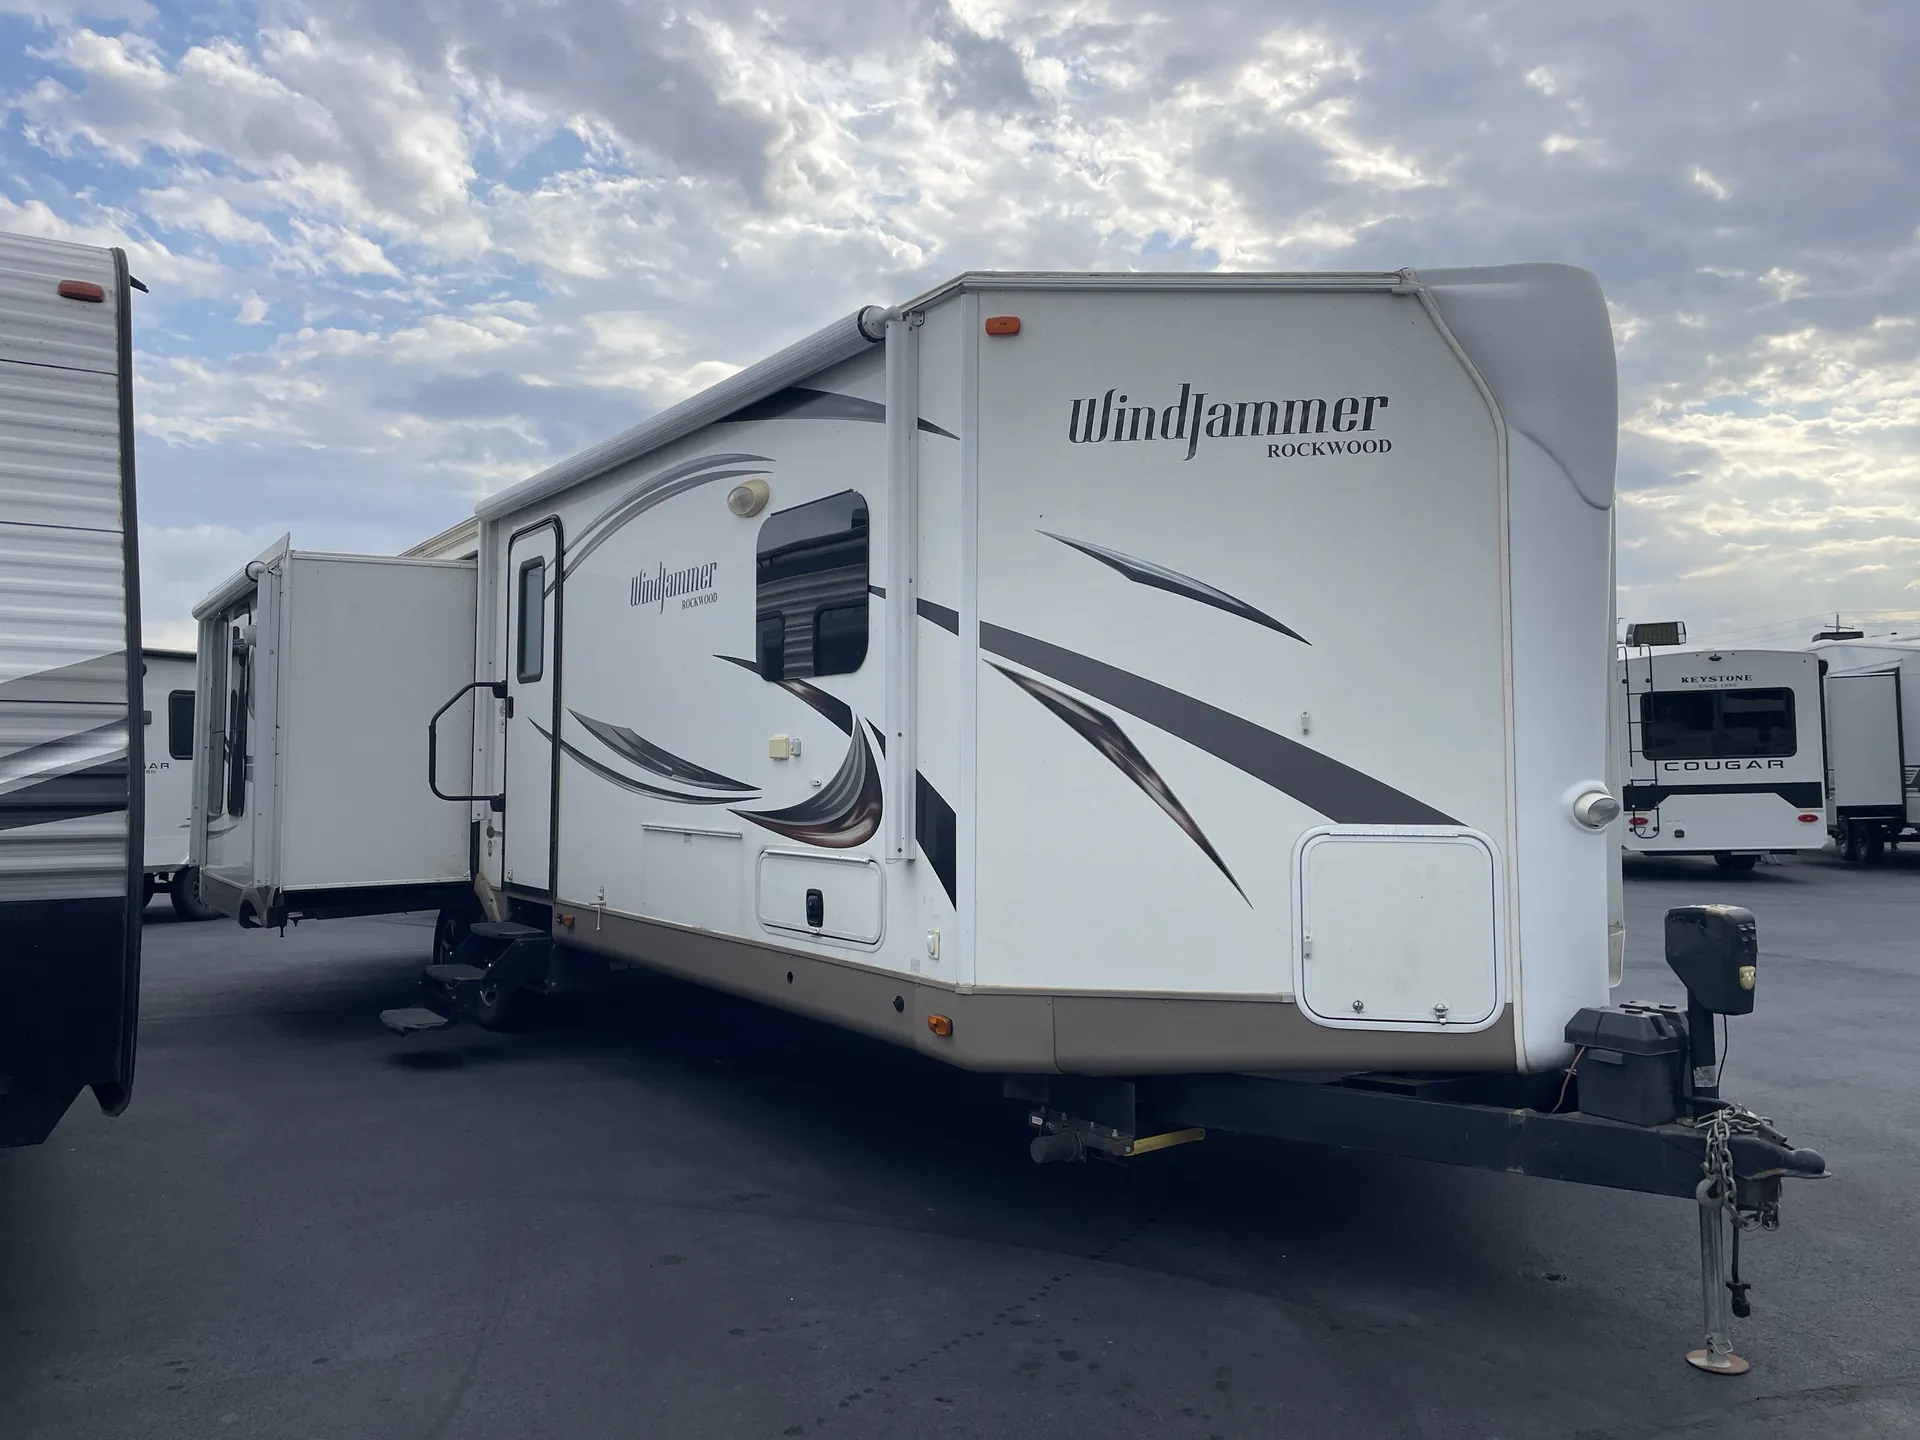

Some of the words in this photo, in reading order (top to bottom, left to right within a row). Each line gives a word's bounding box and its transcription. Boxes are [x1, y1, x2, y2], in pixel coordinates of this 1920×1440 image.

[1068, 382, 1389, 461] WindJammer
[1267, 439, 1392, 458] ROCKWOOD
[630, 561, 718, 615] WindJammer
[681, 592, 718, 610] ROCKWOOD
[1681, 674, 1753, 684] KEYSTONE
[1664, 760, 1784, 771] COUGAR
